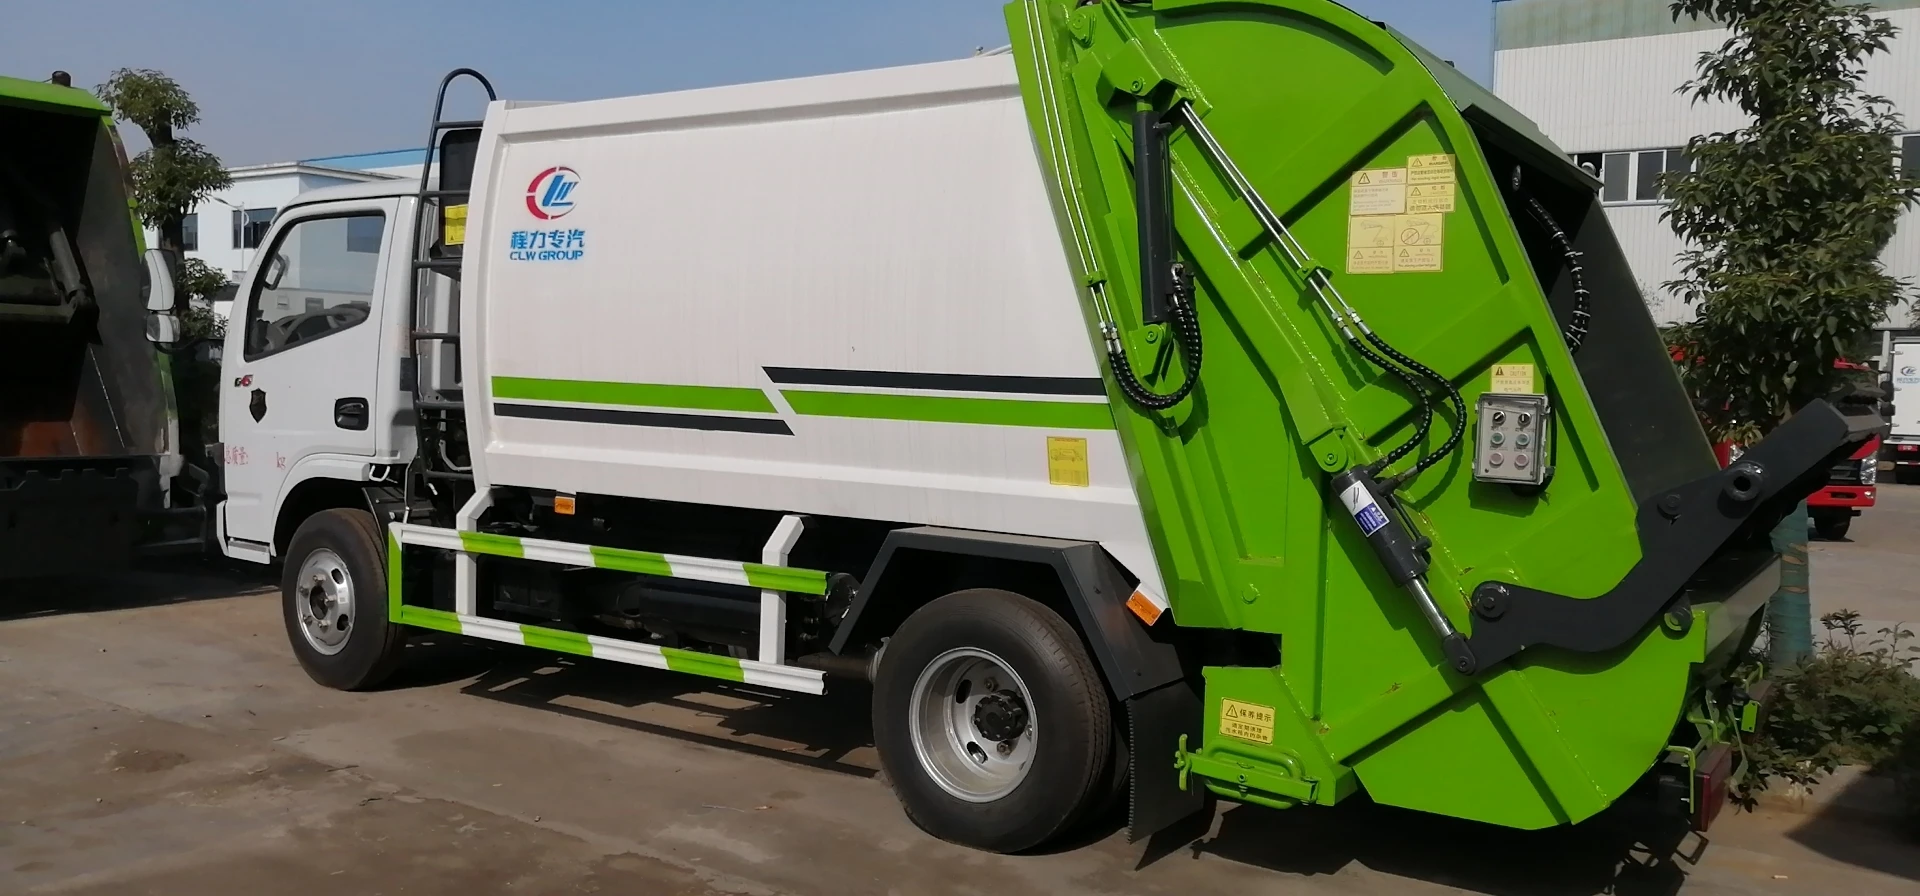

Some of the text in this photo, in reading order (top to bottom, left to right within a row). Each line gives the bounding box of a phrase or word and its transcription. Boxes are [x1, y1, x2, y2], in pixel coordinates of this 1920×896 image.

[510, 229, 585, 249] 程力专汽
[510, 250, 583, 260] CLW GROUP
